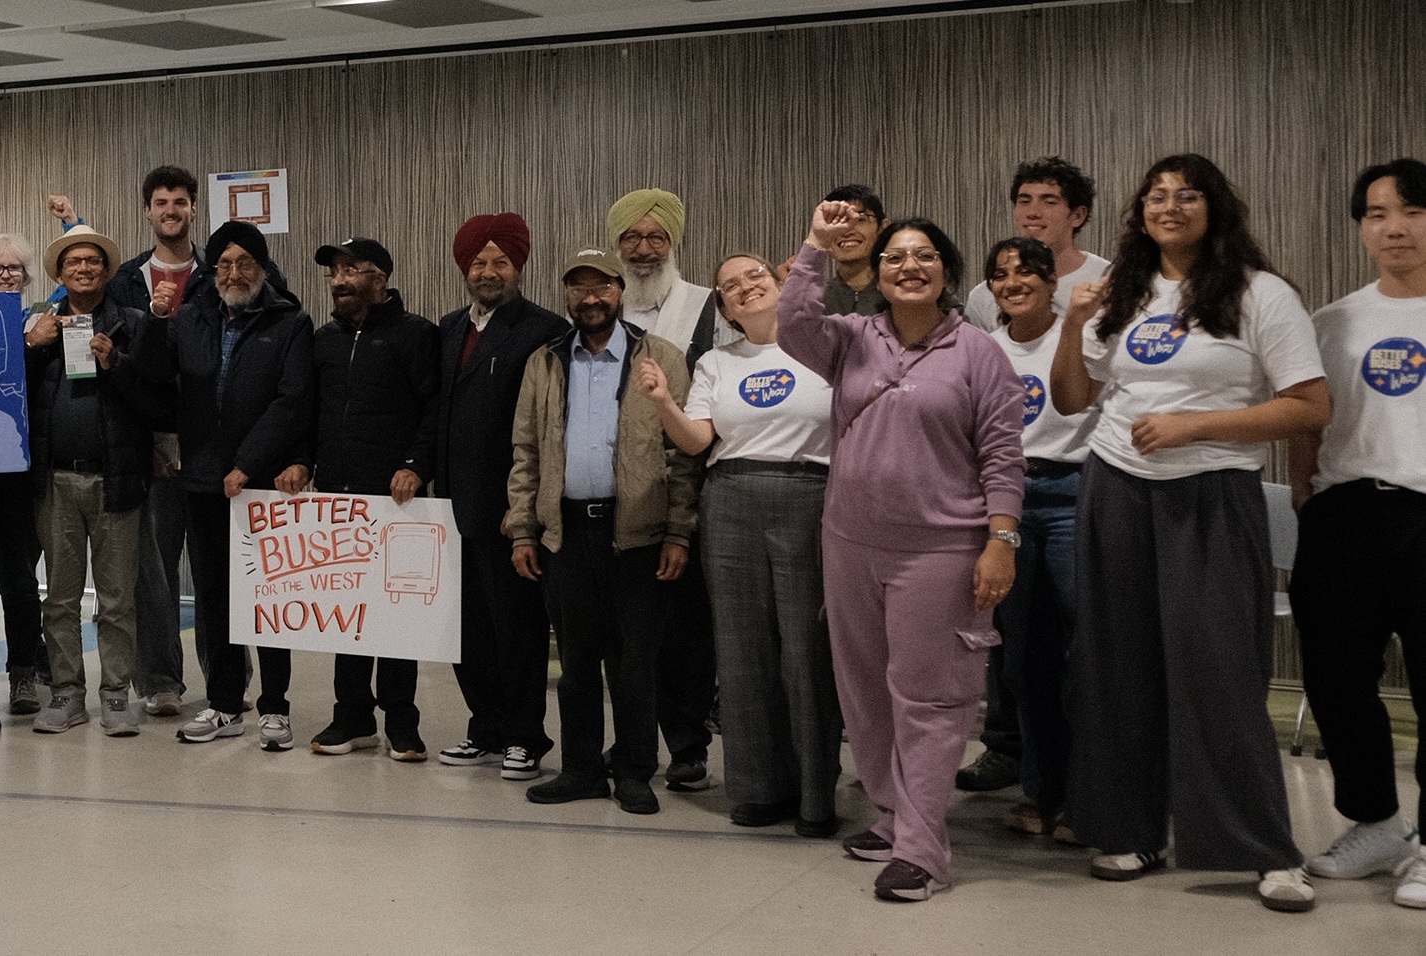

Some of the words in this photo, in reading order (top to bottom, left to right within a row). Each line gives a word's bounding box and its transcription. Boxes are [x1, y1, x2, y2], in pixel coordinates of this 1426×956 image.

[1370, 349, 1408, 359] BETTER
[248, 497, 371, 534] BETTER
[258, 526, 374, 575] BUSES
[255, 584, 278, 599] FOR
[281, 581, 304, 592] THE
[310, 572, 367, 591] WEST
[254, 600, 367, 641] NOW!
